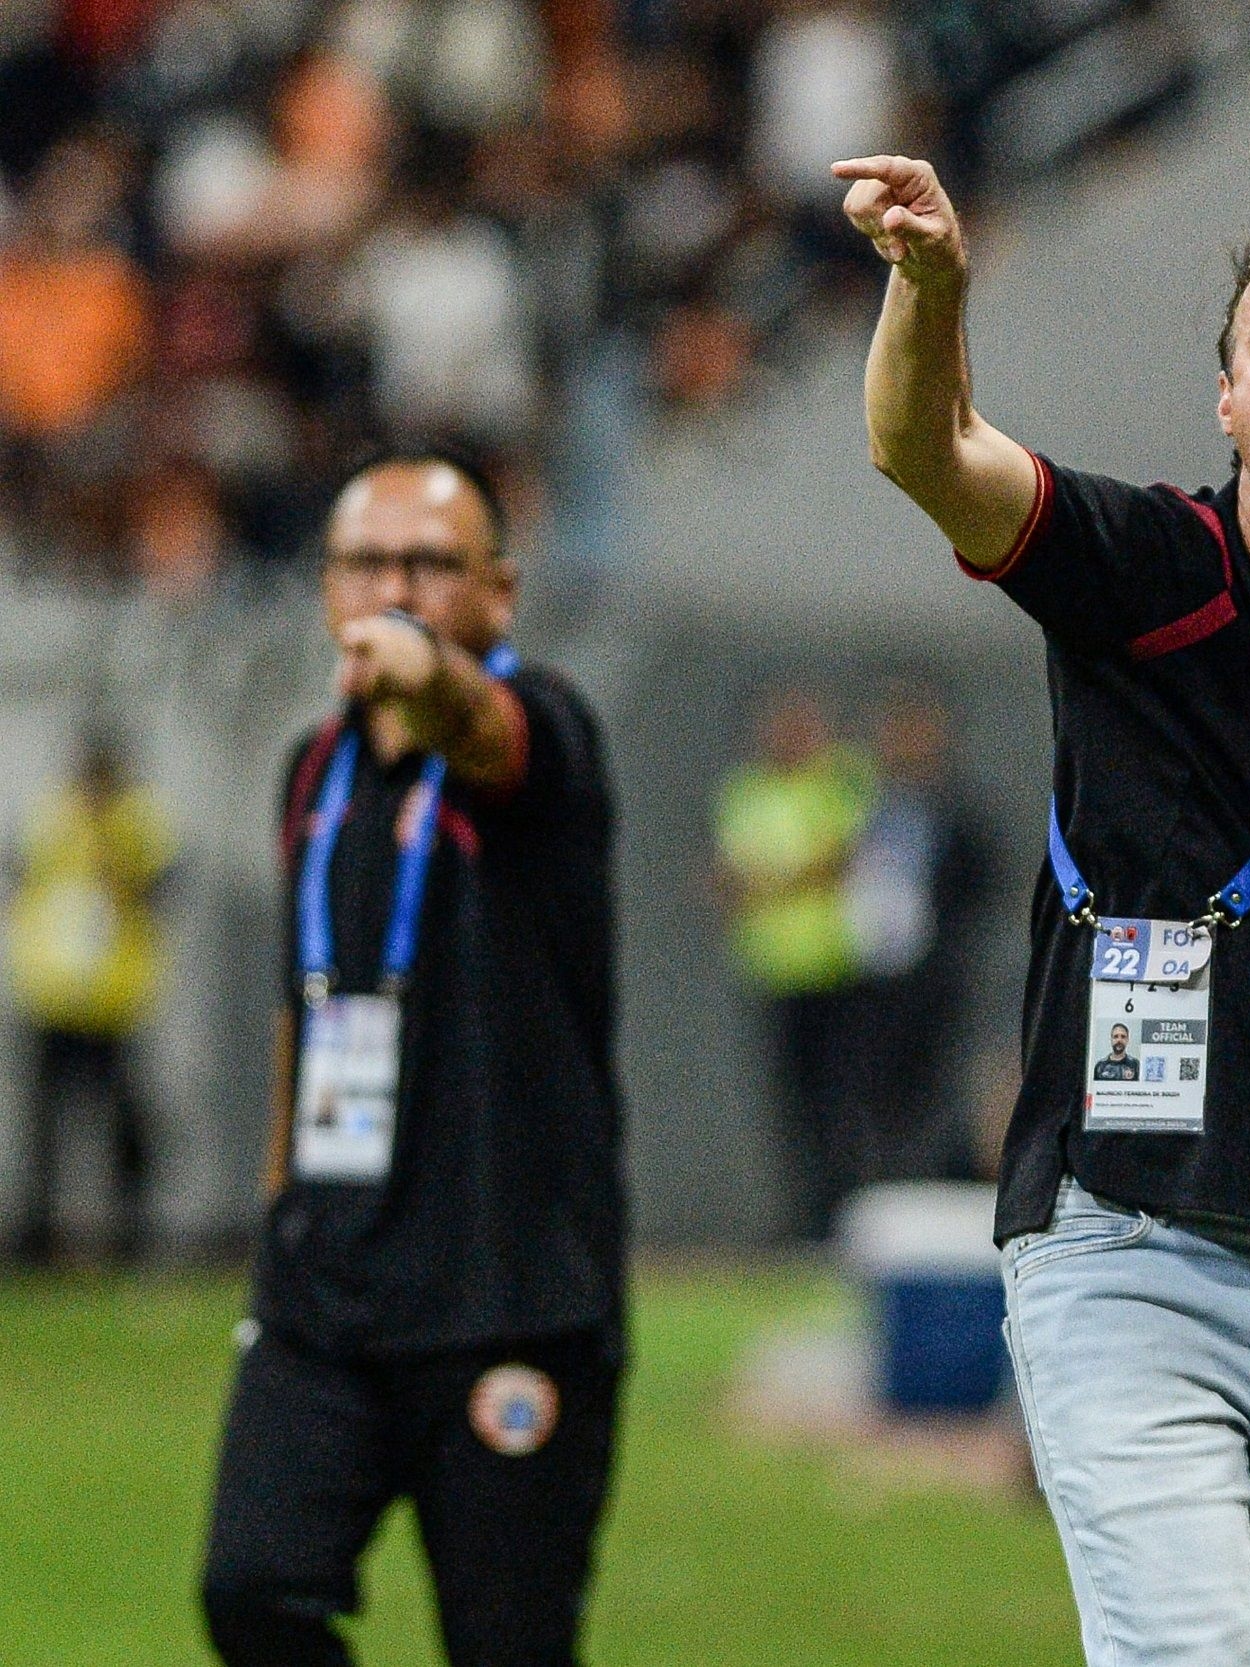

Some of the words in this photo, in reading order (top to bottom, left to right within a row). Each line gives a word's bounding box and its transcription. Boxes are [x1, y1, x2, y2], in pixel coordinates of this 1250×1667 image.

[1101, 948, 1140, 975] 22
[1163, 960, 1189, 975] OA
[1125, 998, 1134, 1013] 6
[1160, 1022, 1186, 1032] TEAM
[1152, 1032, 1194, 1042] OFFICIAL
